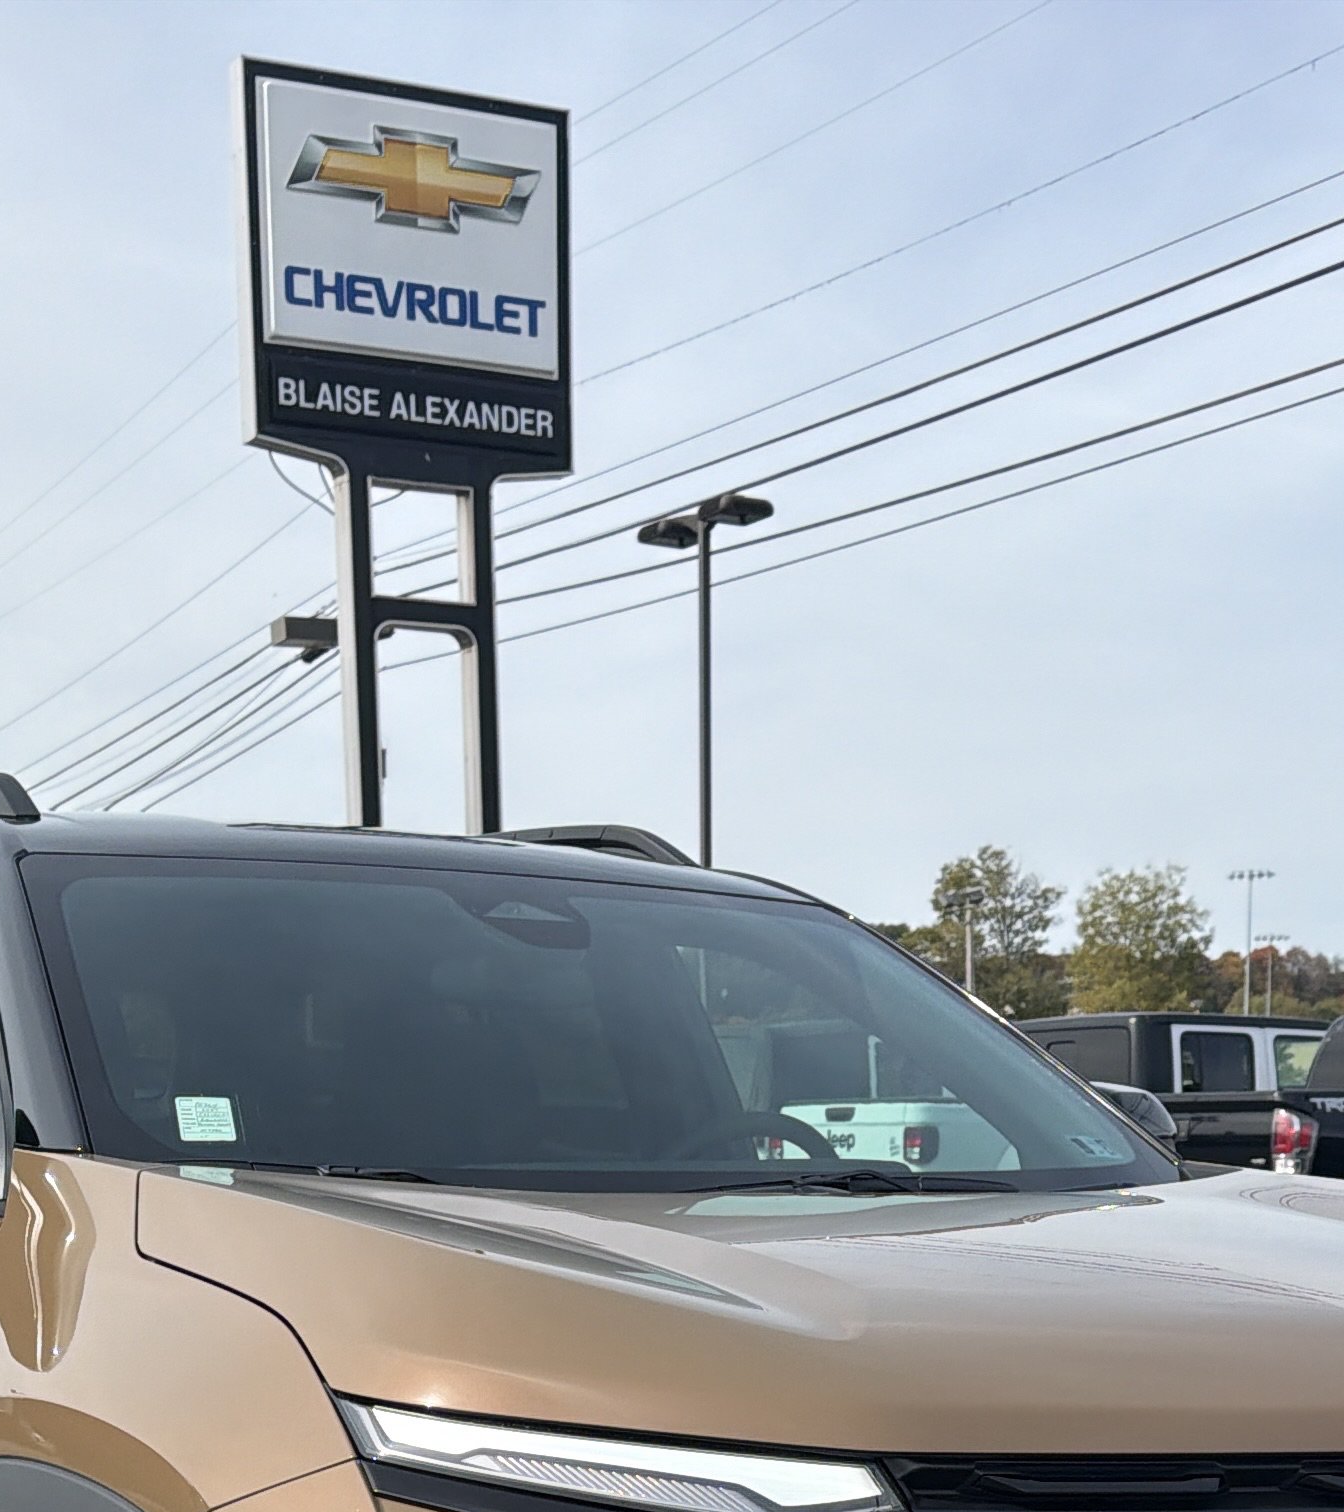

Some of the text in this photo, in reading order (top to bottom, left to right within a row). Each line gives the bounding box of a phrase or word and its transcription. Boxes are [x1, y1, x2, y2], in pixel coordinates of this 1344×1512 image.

[284, 265, 546, 338] CHEVROLET
[277, 376, 554, 439] BLAISE ALEXANDER
